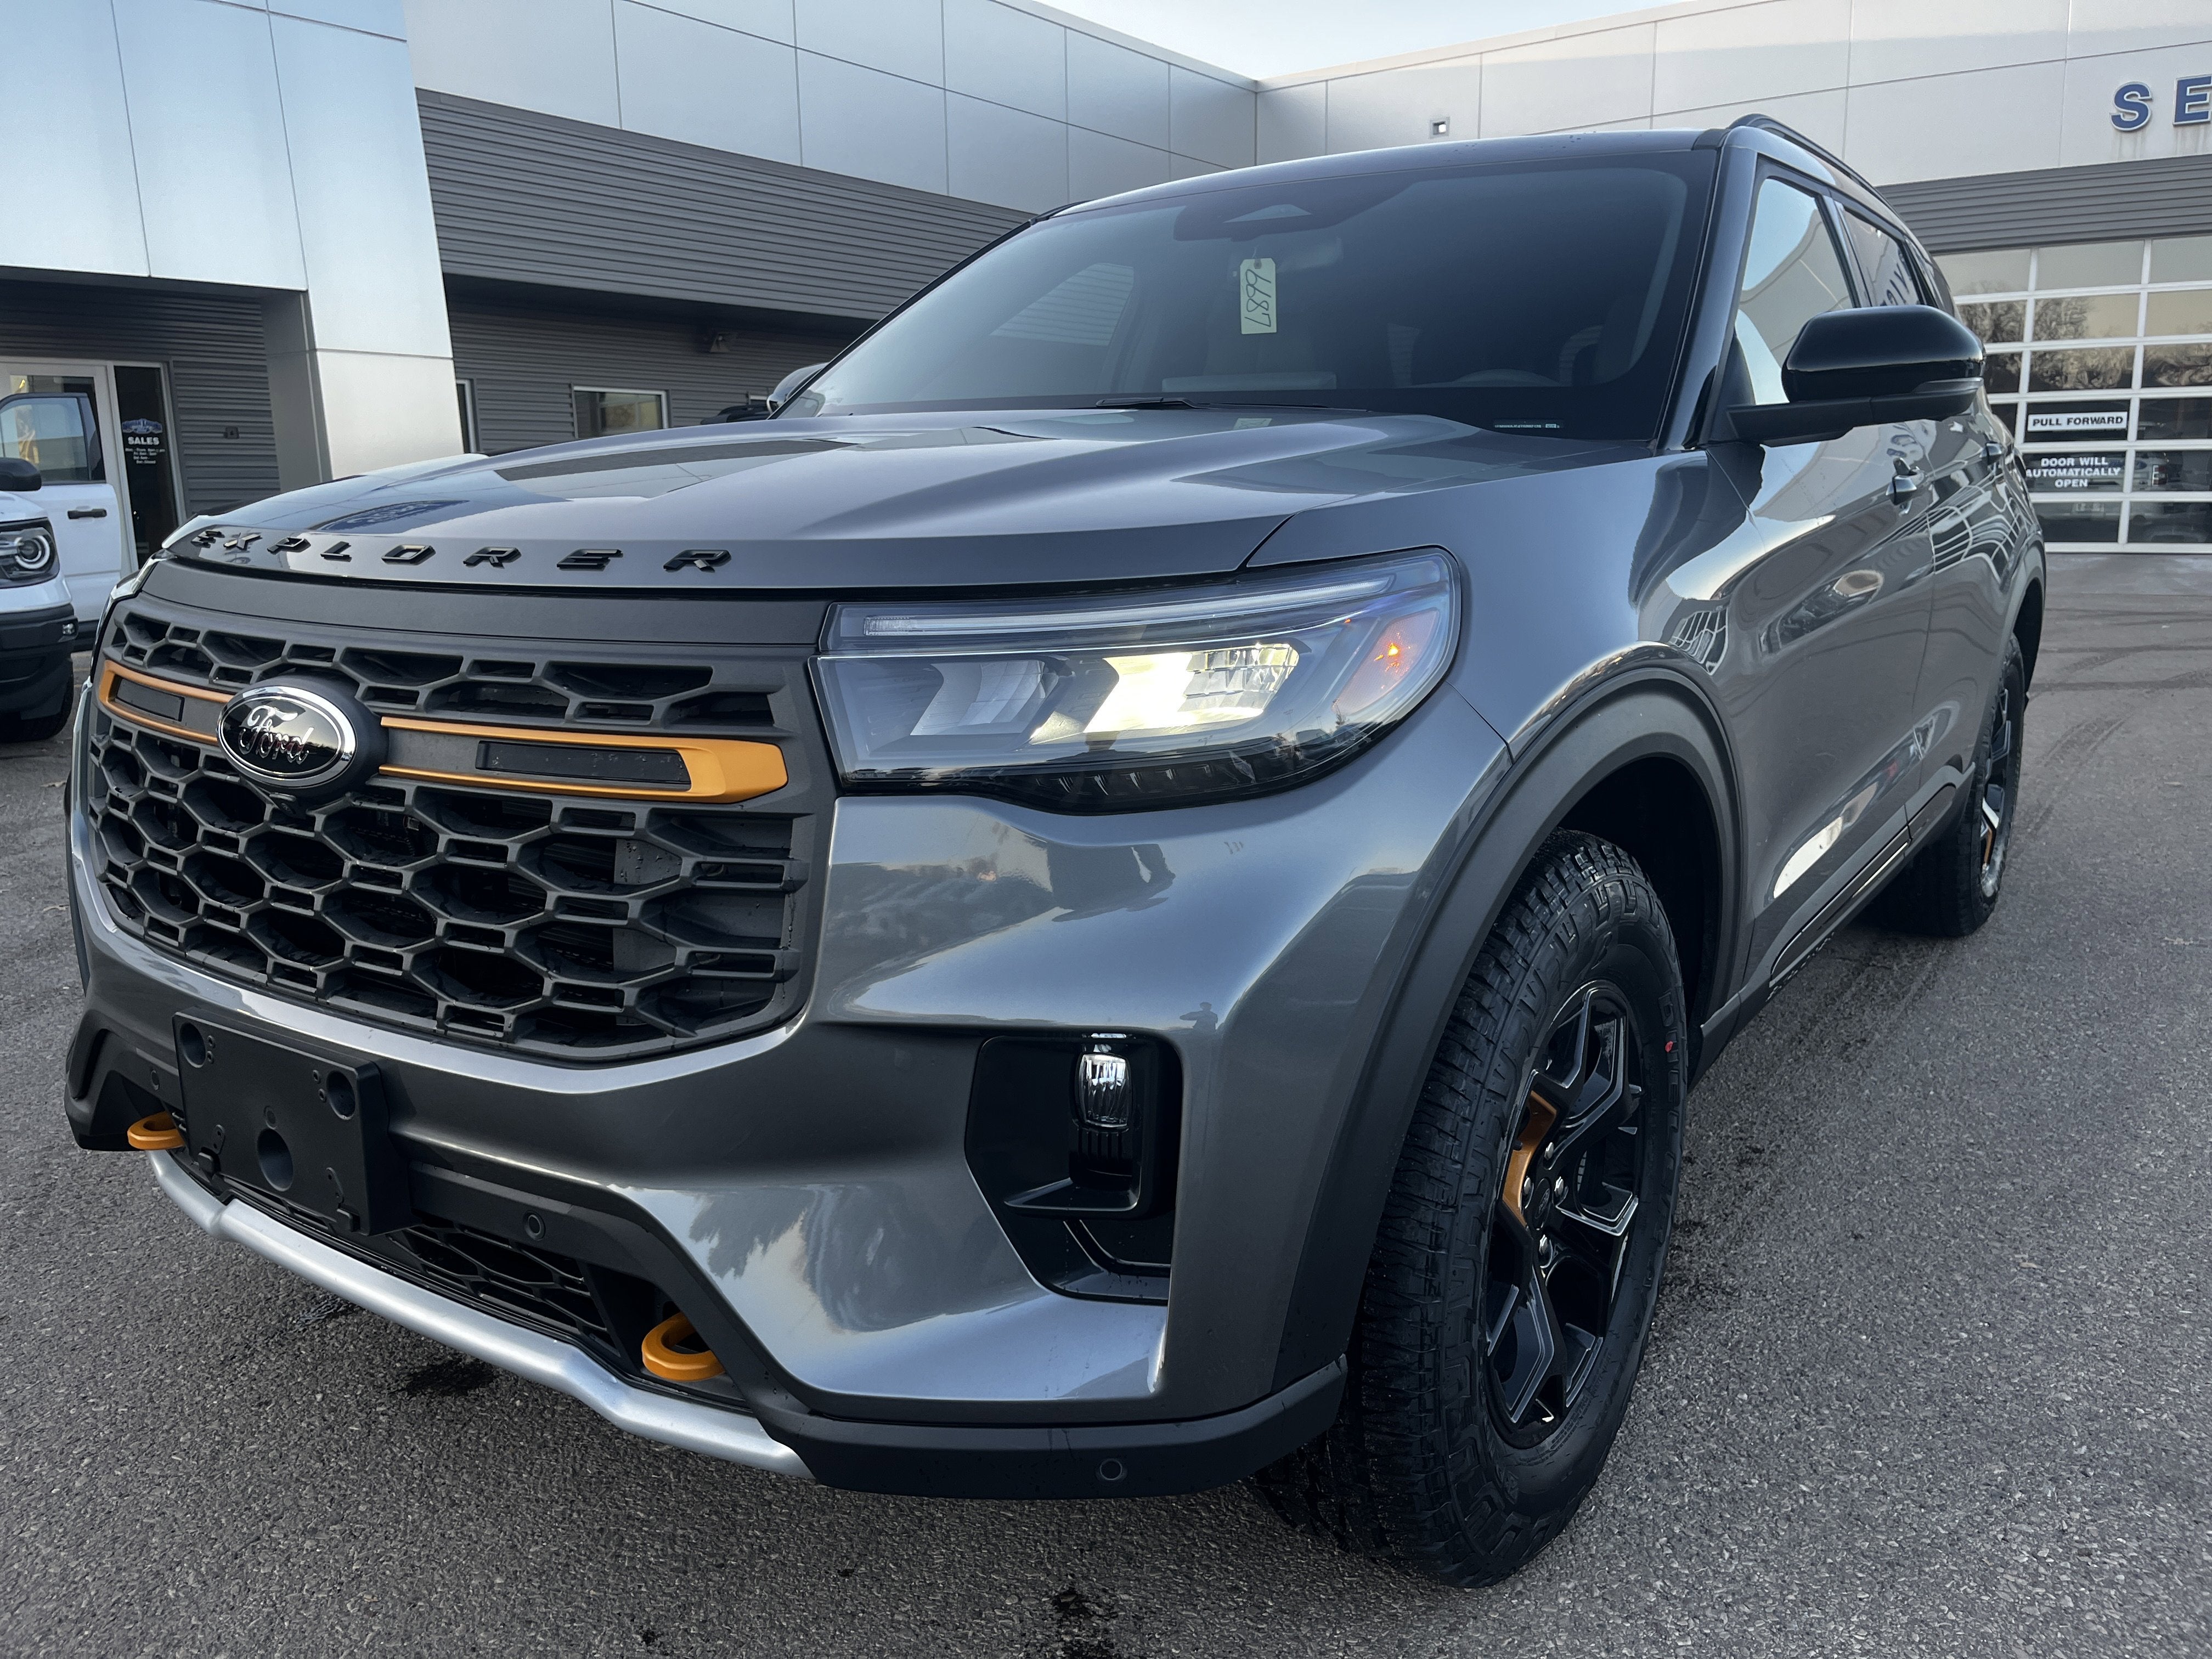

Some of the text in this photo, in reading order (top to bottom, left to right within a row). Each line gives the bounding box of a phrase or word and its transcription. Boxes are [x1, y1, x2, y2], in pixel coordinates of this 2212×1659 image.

[2110, 74, 2212, 132] SE
[1245, 268, 1272, 328] 6687
[2033, 416, 2123, 426] PULL FORWARD
[128, 436, 160, 445] SALES
[2041, 456, 2108, 467] DOOR WILL
[2025, 467, 2121, 478] AUTOMATICALLY
[2055, 479, 2088, 488] OPEN
[190, 529, 732, 573] EXPLORER
[238, 705, 314, 765] Ford
